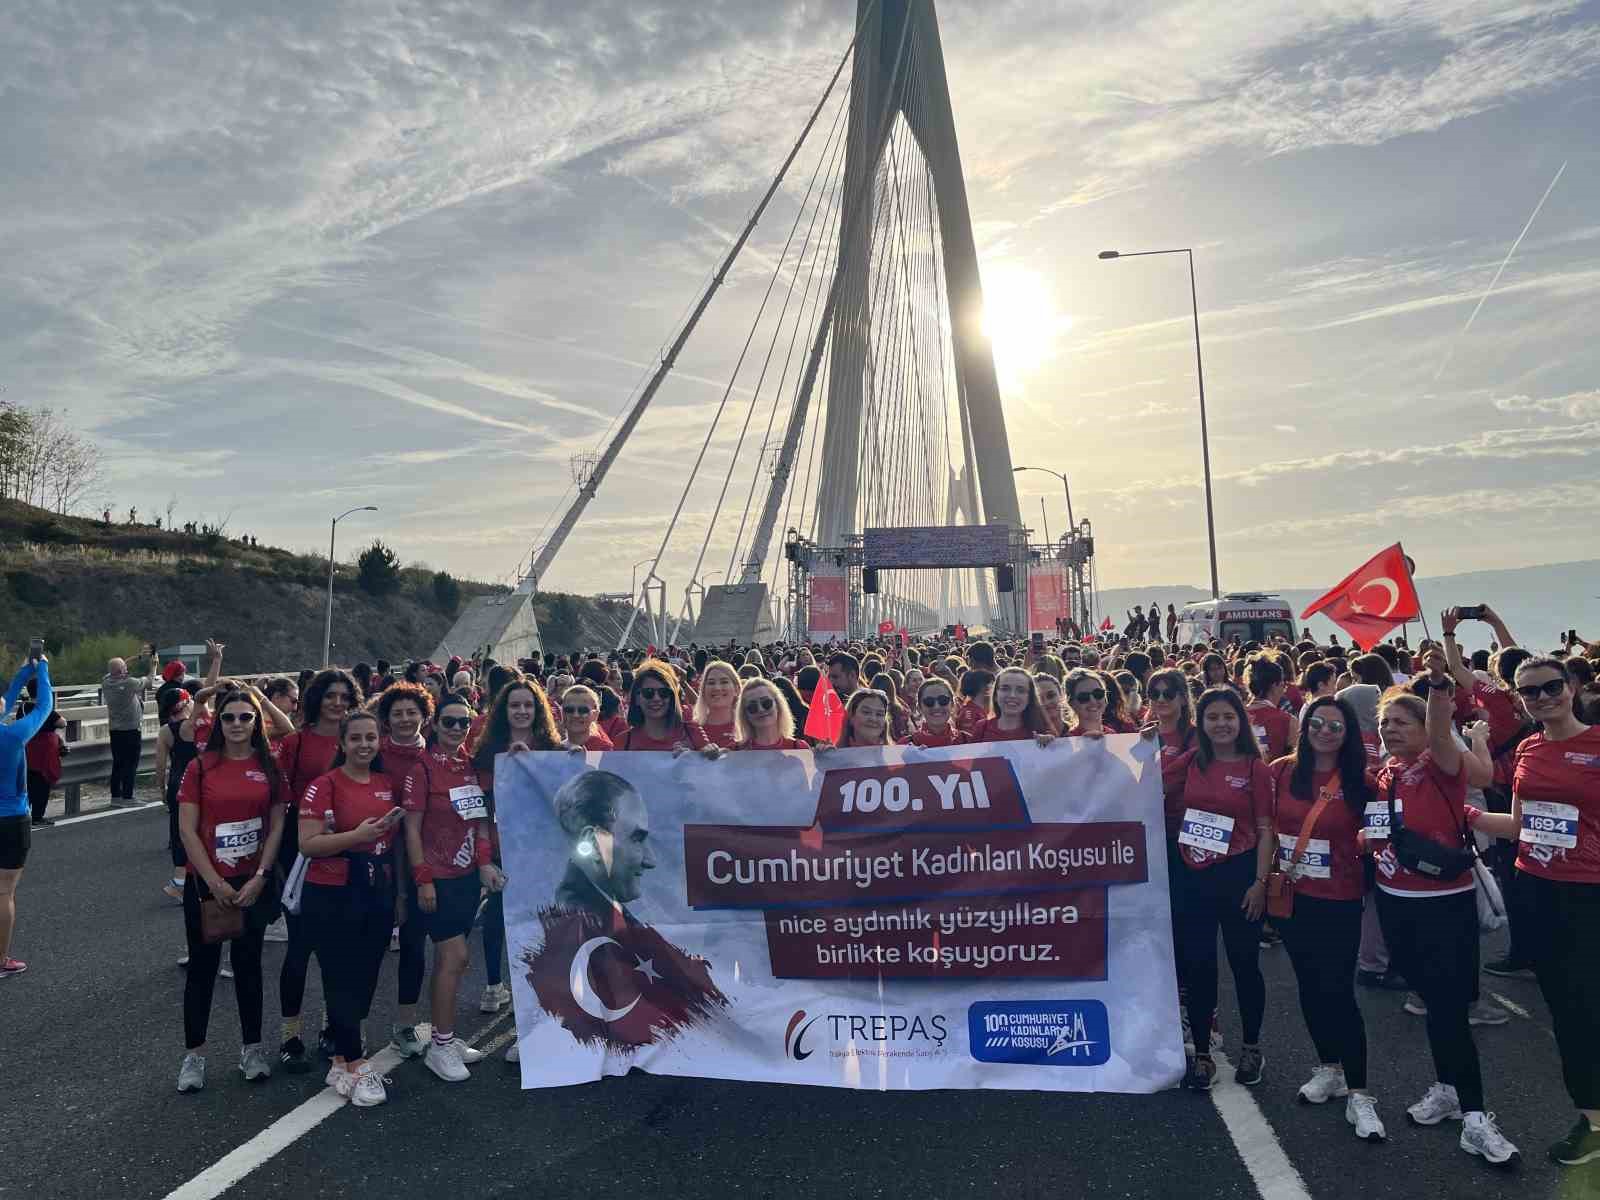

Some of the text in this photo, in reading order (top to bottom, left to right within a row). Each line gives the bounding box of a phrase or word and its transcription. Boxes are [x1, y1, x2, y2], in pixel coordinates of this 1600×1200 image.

[1225, 609, 1282, 619] AMBULANS
[839, 778, 924, 813] 100.
[1188, 823, 1223, 841] 1699
[1529, 816, 1569, 833] 1694
[222, 831, 258, 847] 1403
[706, 840, 1136, 888] Cumhuriyet Kadınları Koşusu ile
[1284, 849, 1322, 866] 192
[779, 901, 1079, 938] nice aydınlık yüzyıllara
[816, 940, 1061, 969] birlikte koşuyoruz.
[827, 1014, 948, 1047] TREPAŞ
[1011, 1037, 1048, 1049] KOŞUSU
